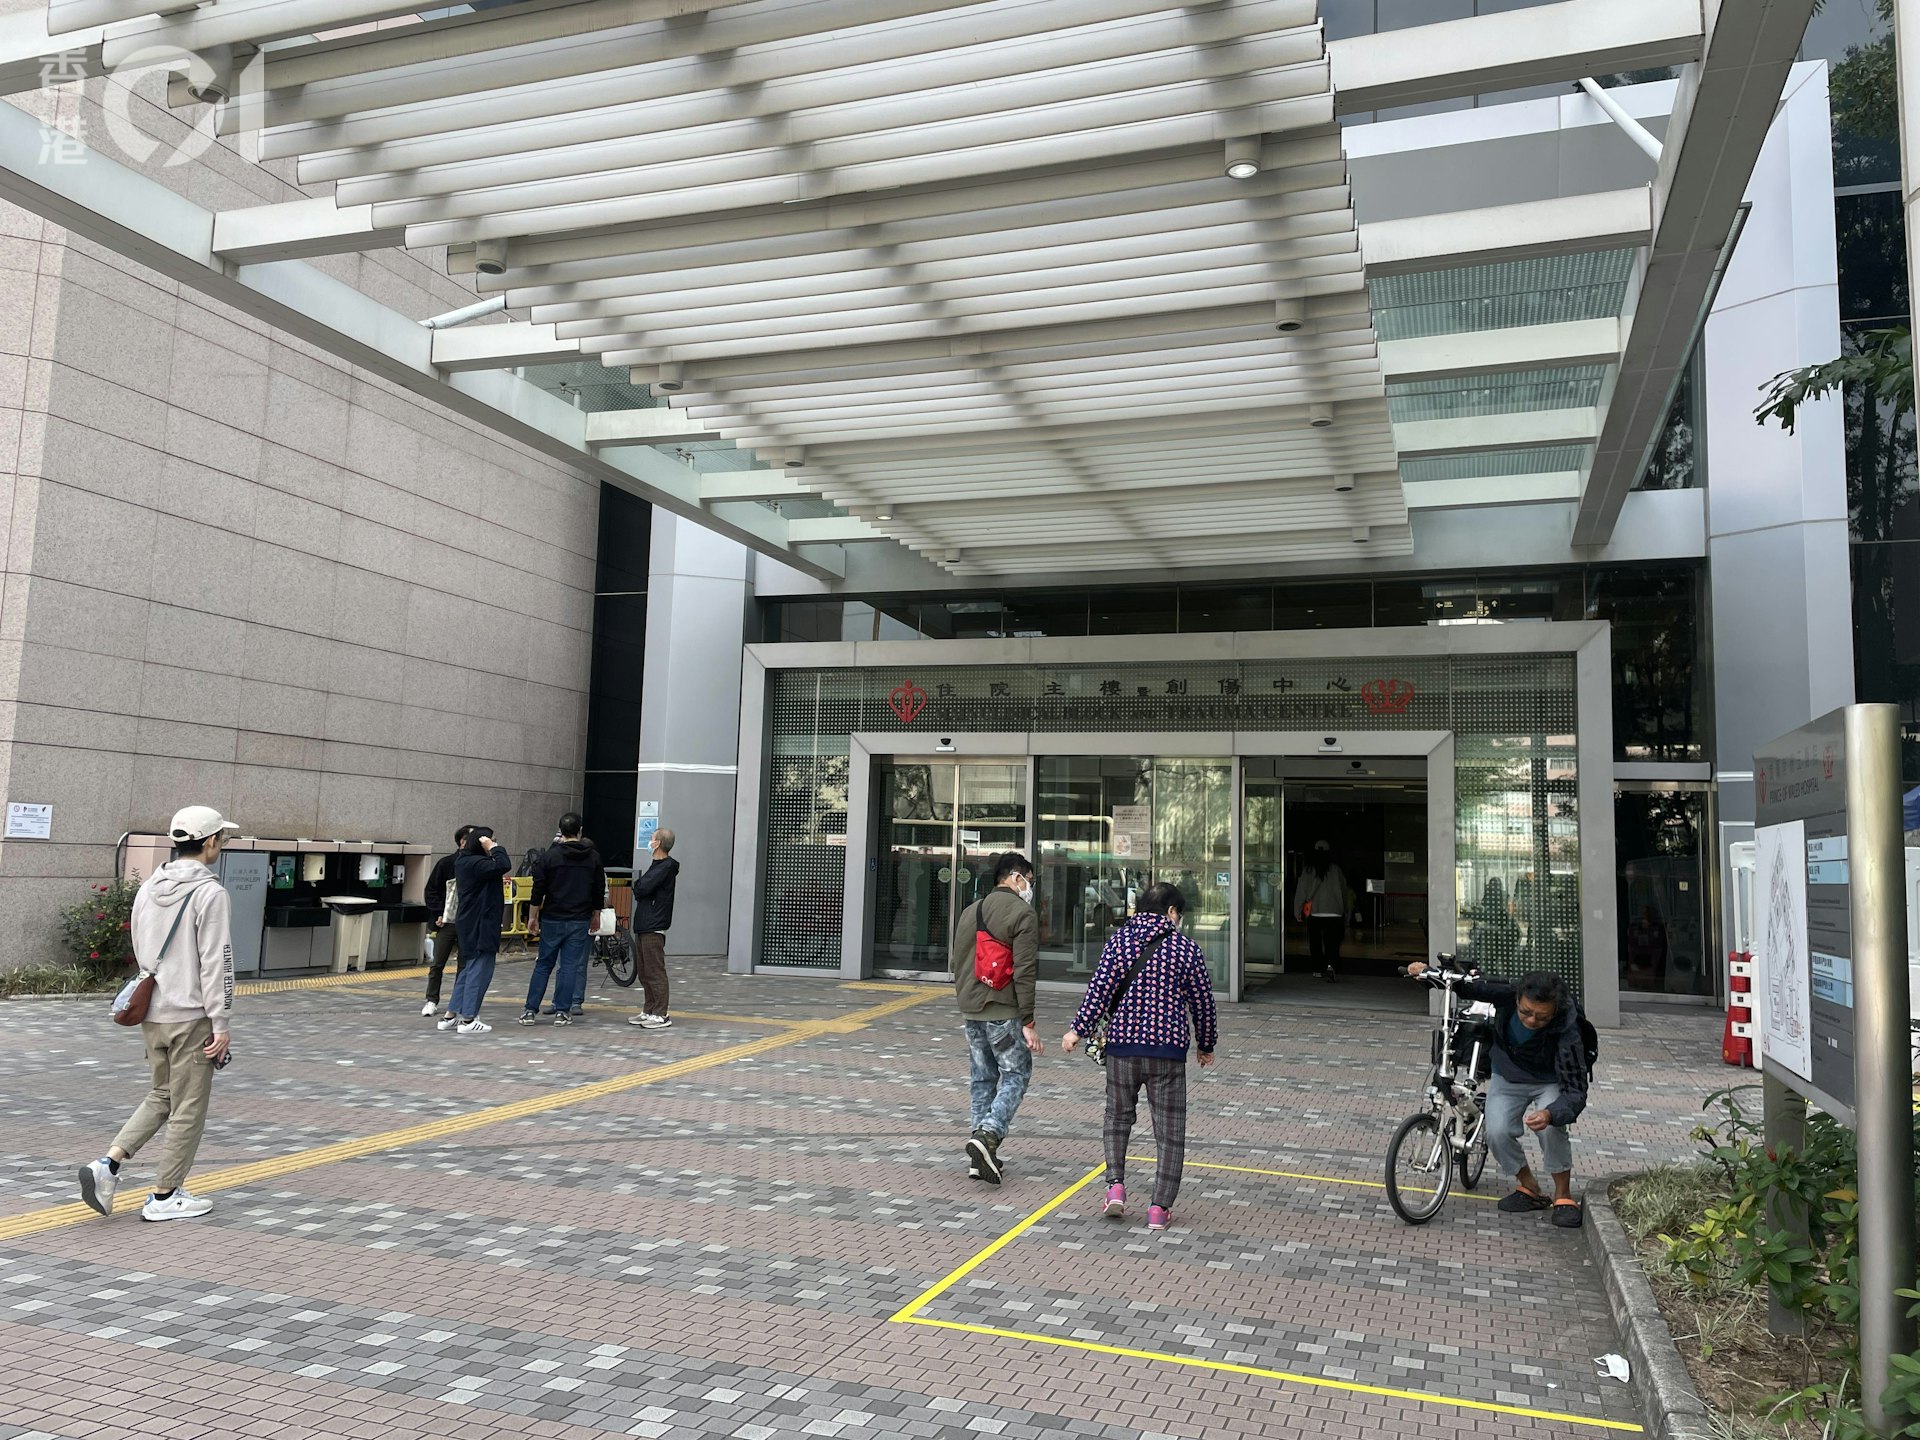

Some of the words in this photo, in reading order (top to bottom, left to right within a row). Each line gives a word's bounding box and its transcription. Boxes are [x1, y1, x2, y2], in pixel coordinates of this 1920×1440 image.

[1167, 704, 1256, 719] TRAUMA
[1263, 703, 1353, 718] CENTRE
[223, 944, 232, 973] HUNTER
[223, 976, 233, 1010] MONSTER
